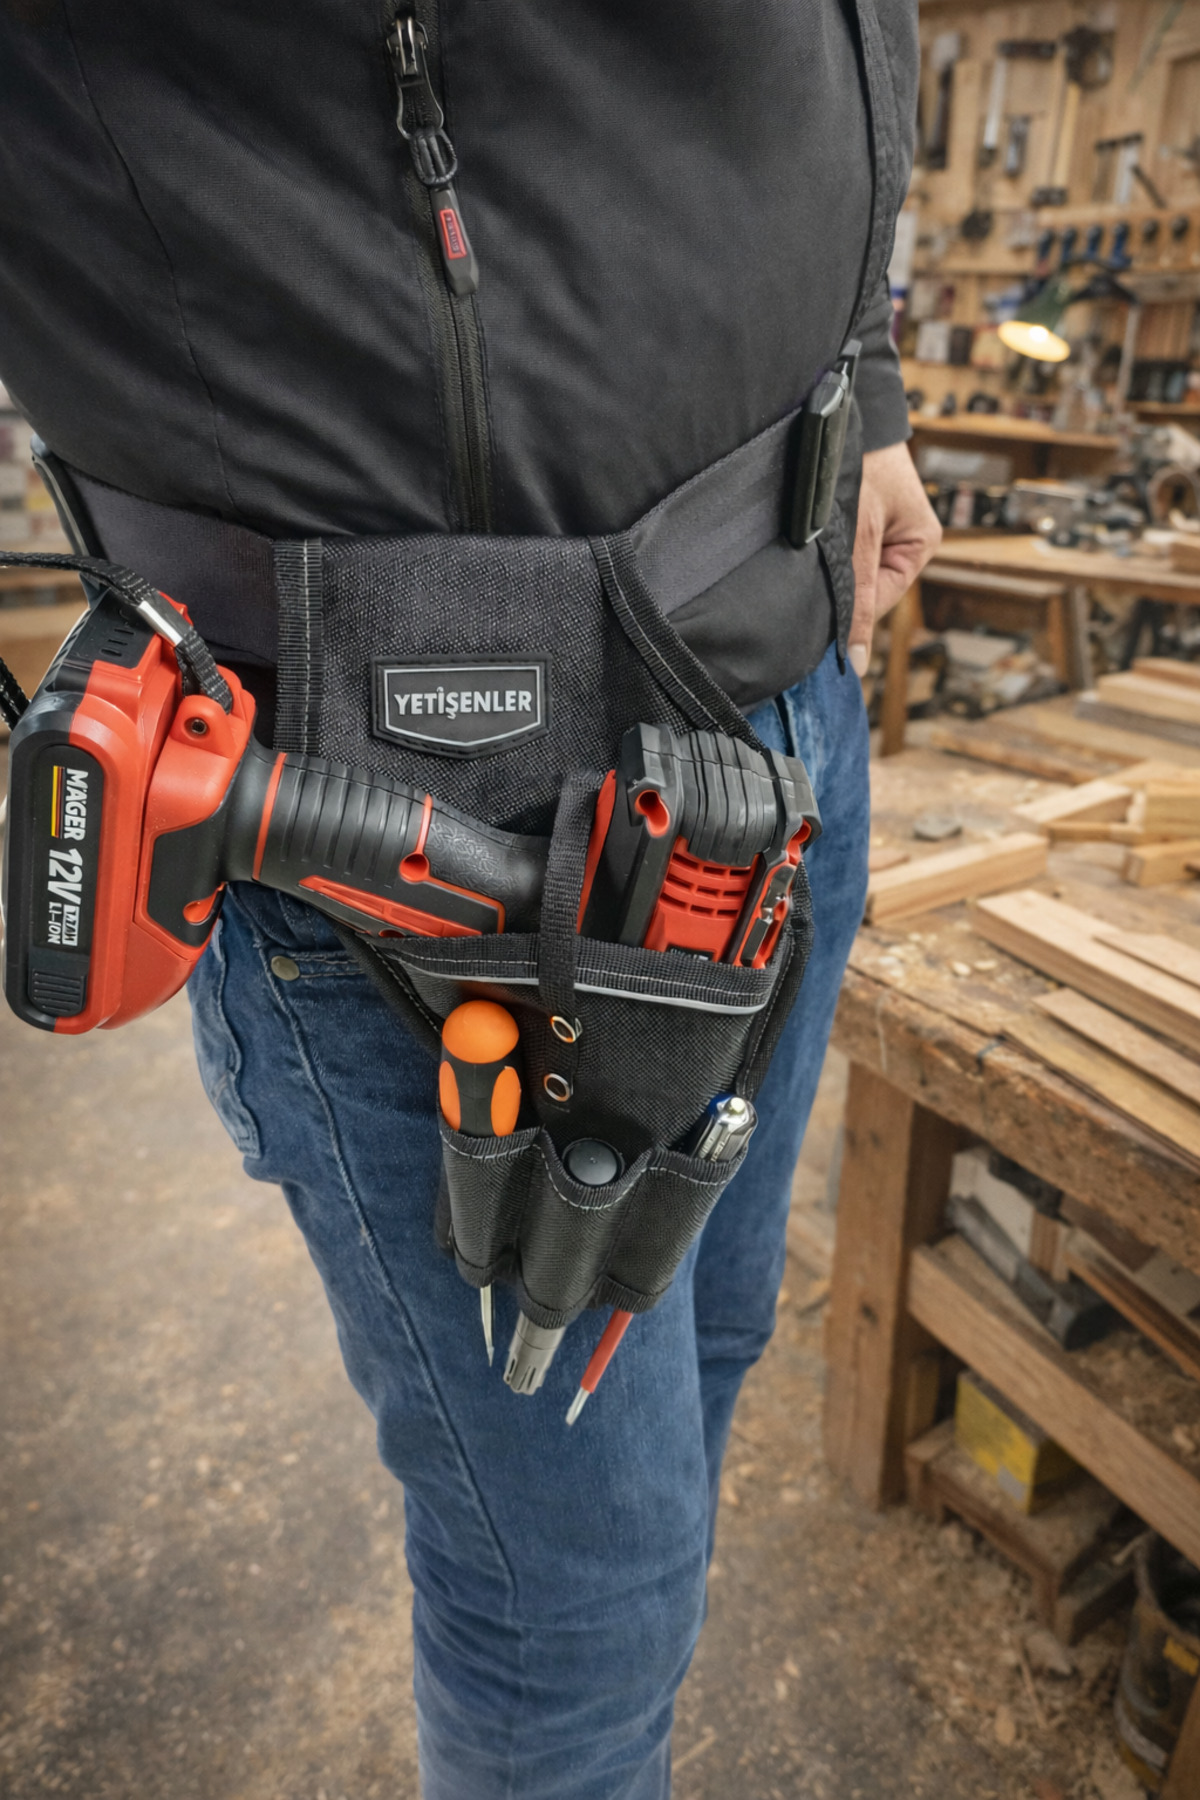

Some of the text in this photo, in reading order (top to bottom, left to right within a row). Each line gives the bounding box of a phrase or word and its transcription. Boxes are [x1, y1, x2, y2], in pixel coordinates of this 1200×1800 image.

[394, 686, 532, 720] YETİŞENLER
[47, 848, 83, 905] 12V
[47, 901, 62, 945] LI-ION
